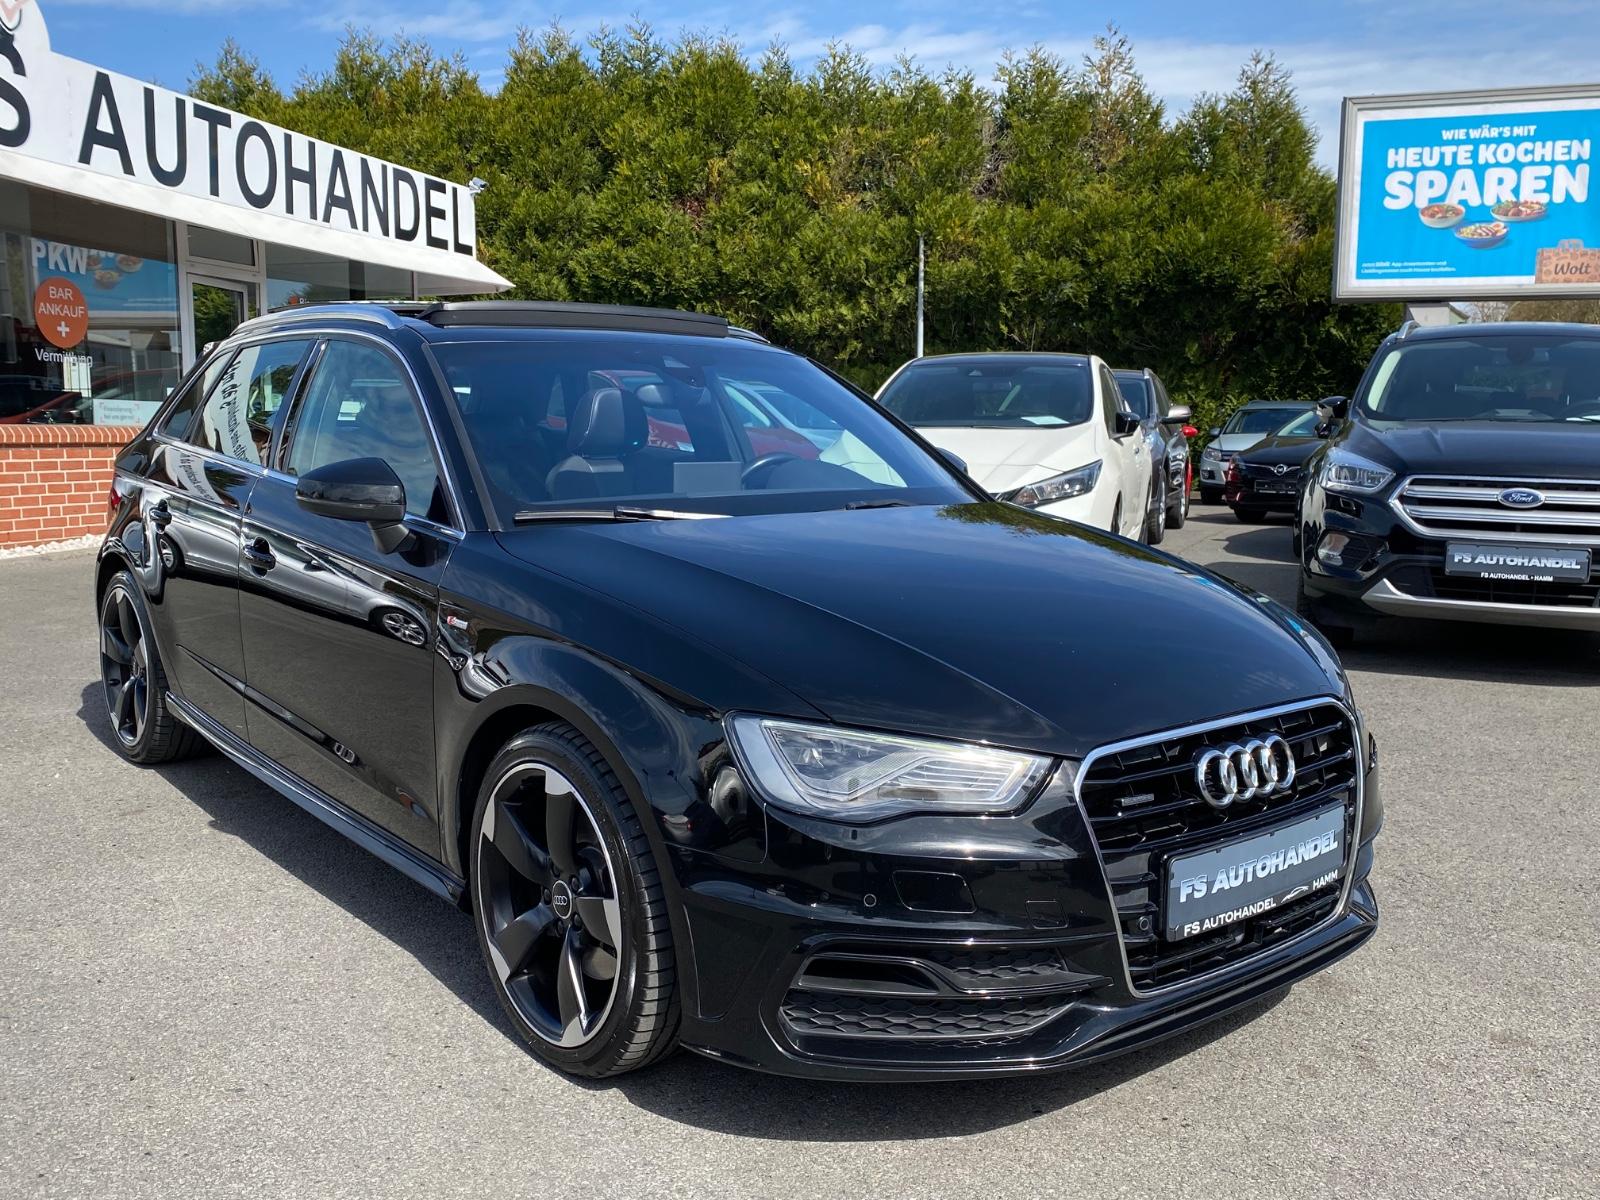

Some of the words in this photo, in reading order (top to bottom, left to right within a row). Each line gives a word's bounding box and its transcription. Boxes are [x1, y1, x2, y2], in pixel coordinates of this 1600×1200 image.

[1441, 129, 1467, 140] WIE
[1513, 125, 1537, 137] MIT
[78, 70, 473, 256] AUTOHANDEL
[1387, 144, 1474, 169] HEUTE
[1478, 139, 1591, 165] KOCHEN
[1383, 163, 1590, 210] SPAREN
[31, 237, 88, 275] PKW
[1554, 262, 1592, 275] Wolt
[49, 286, 73, 300] BAR
[38, 302, 85, 318] ANKAUF
[1508, 492, 1533, 502] Ford
[1454, 553, 1472, 563] FS
[1474, 554, 1581, 569] AUTOHANDEL
[1179, 873, 1208, 902] FS
[1211, 830, 1338, 894] AUTOHANDEL
[1184, 921, 1201, 936] FS
[1202, 898, 1276, 931] AUTOHANDEL
[1312, 870, 1338, 890] HAMM
